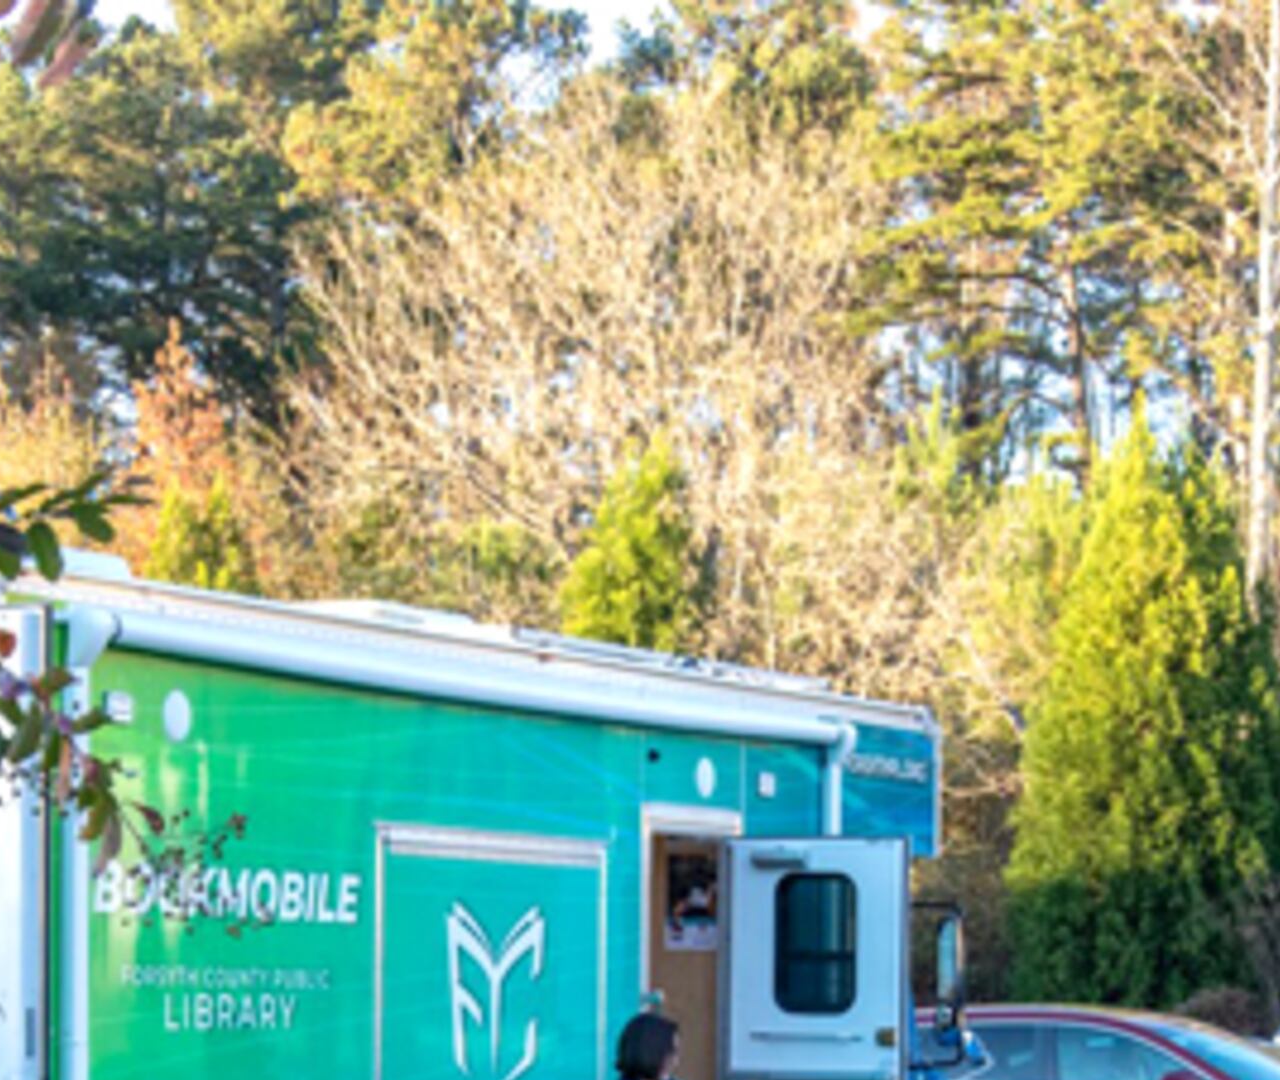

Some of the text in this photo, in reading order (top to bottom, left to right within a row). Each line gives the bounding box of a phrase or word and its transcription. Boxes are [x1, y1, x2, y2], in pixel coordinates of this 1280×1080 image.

[203, 965, 269, 990] COUNTY
[273, 968, 331, 990] PUBLIC
[164, 993, 296, 1032] LIBRARY
